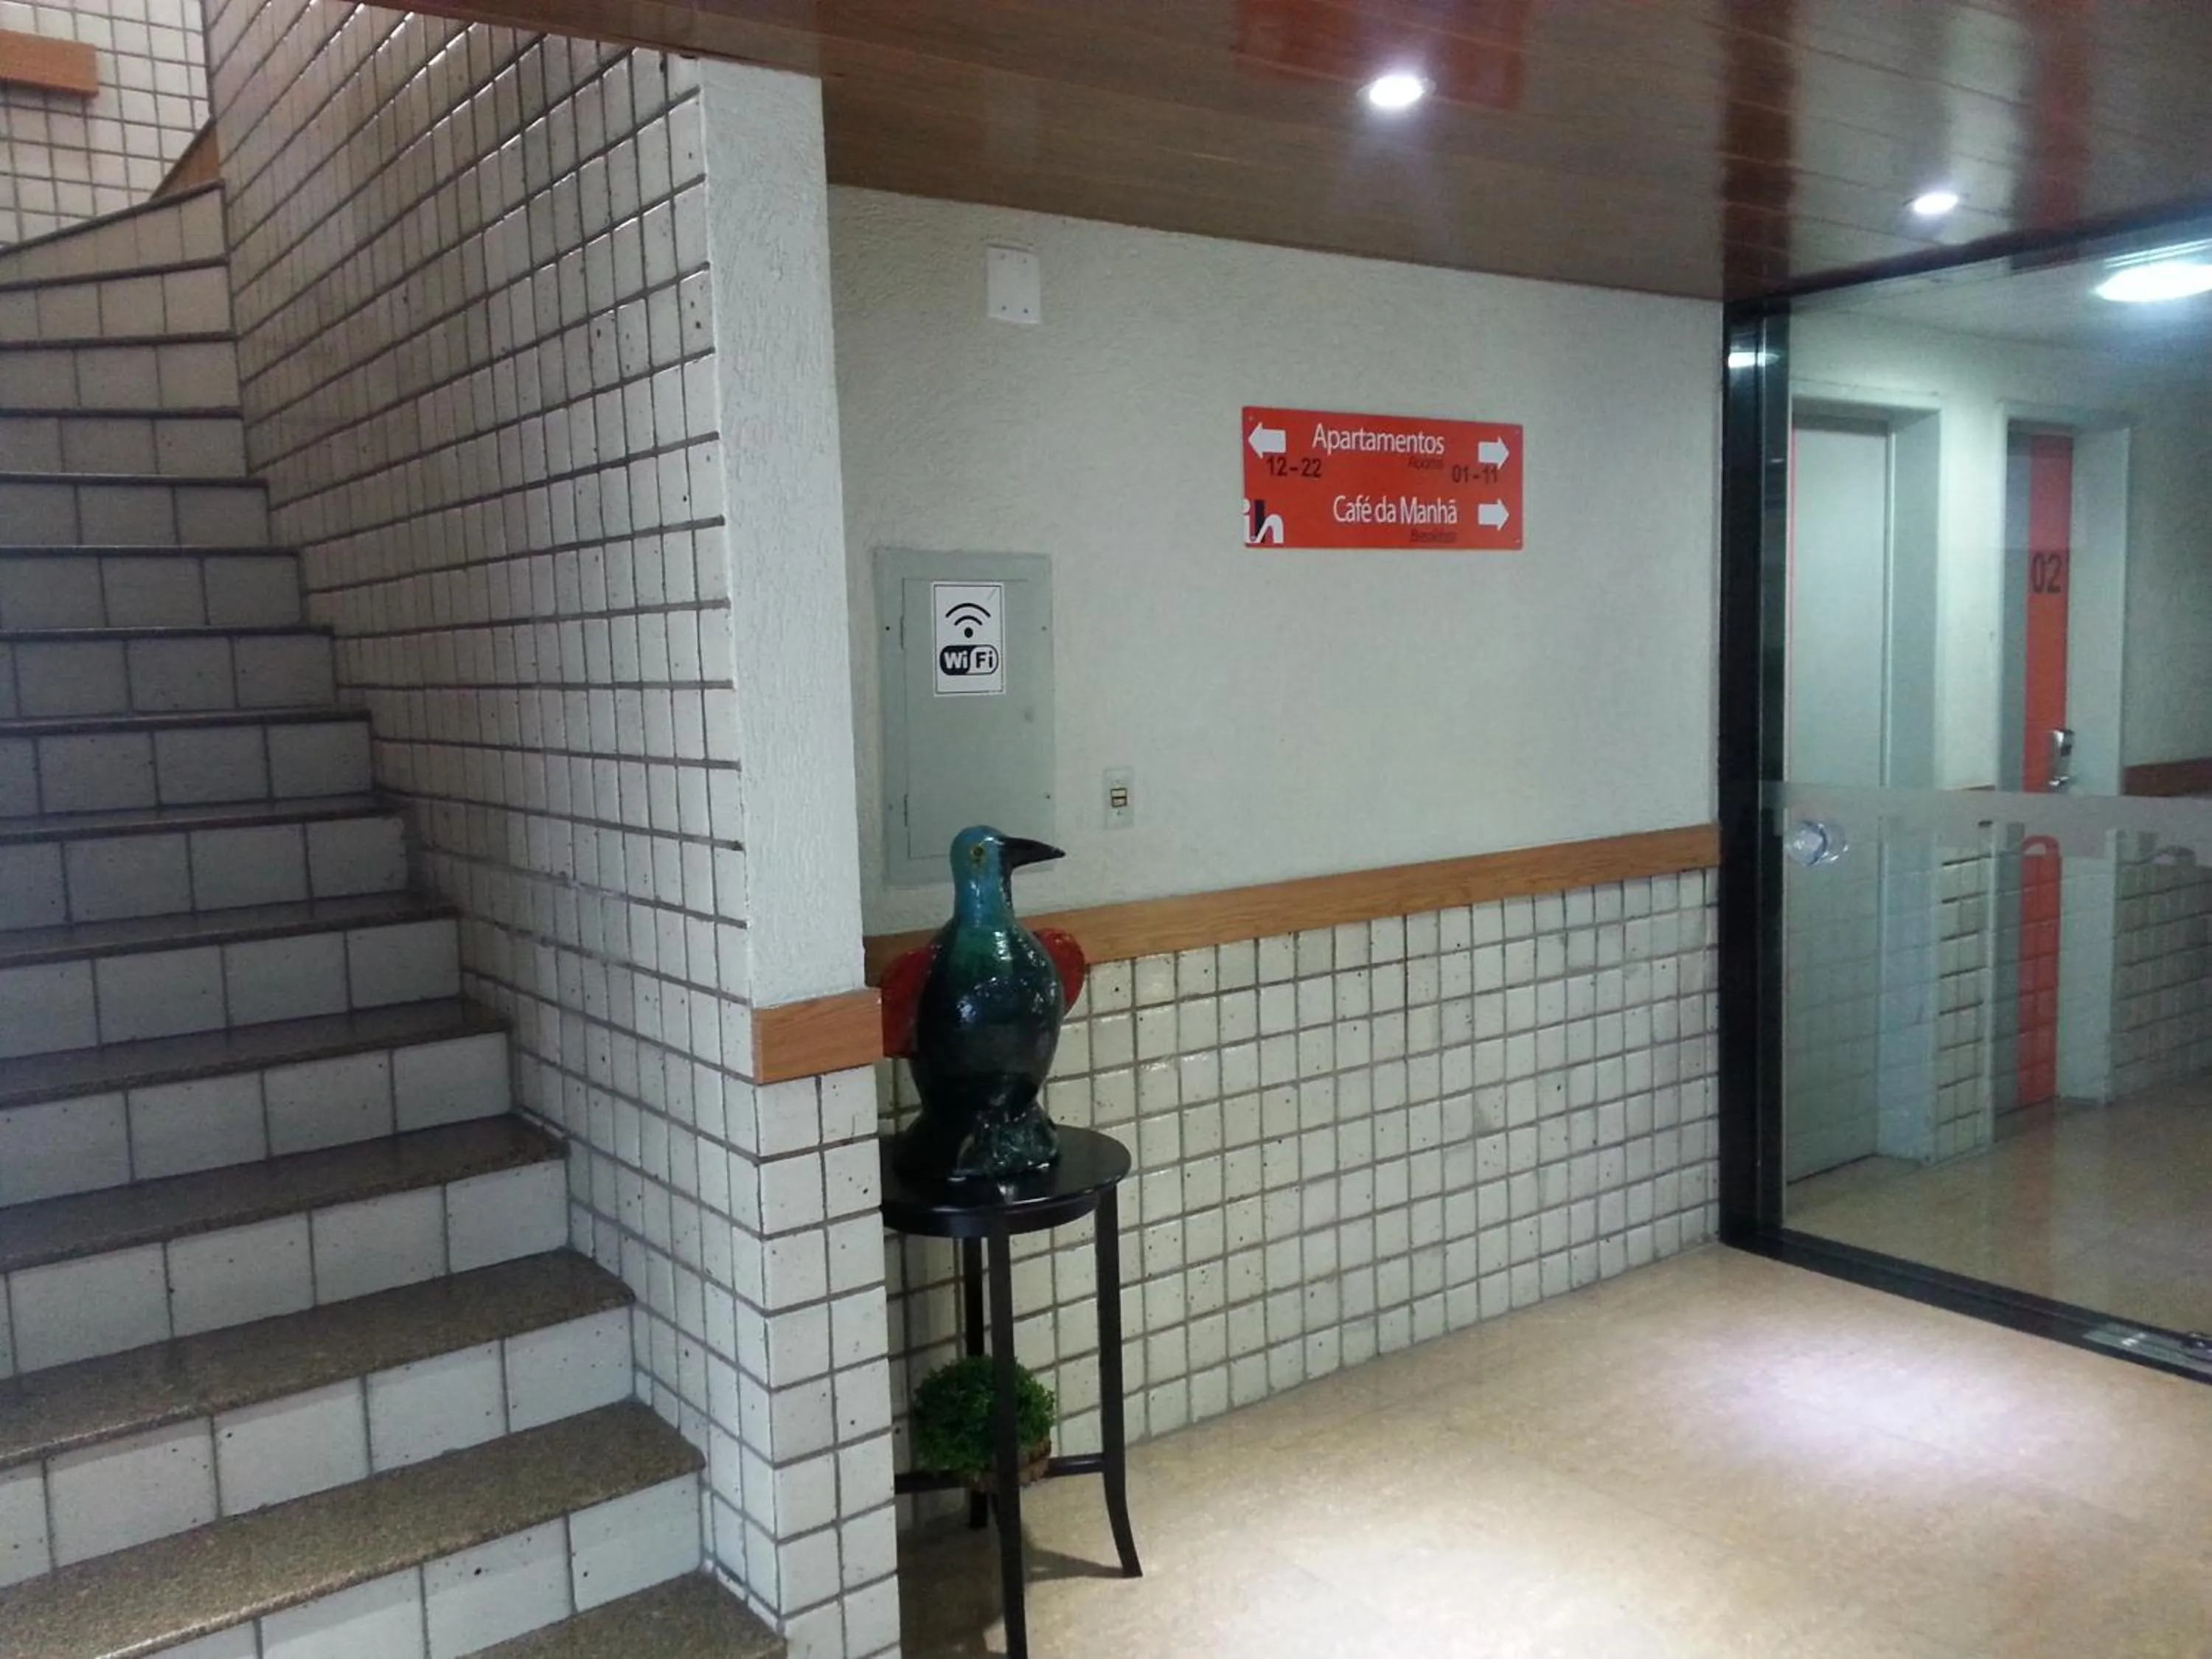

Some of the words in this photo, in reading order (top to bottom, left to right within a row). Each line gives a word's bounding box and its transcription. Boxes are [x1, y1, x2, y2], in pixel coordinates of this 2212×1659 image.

[1312, 422, 1445, 456] Apartamentos
[1266, 456, 1323, 478] 12-22
[1452, 464, 1498, 484] 01-11
[1333, 495, 1372, 523] Café
[1375, 497, 1396, 523] da
[1400, 496, 1458, 524] Manhã
[2031, 552, 2062, 594] 02
